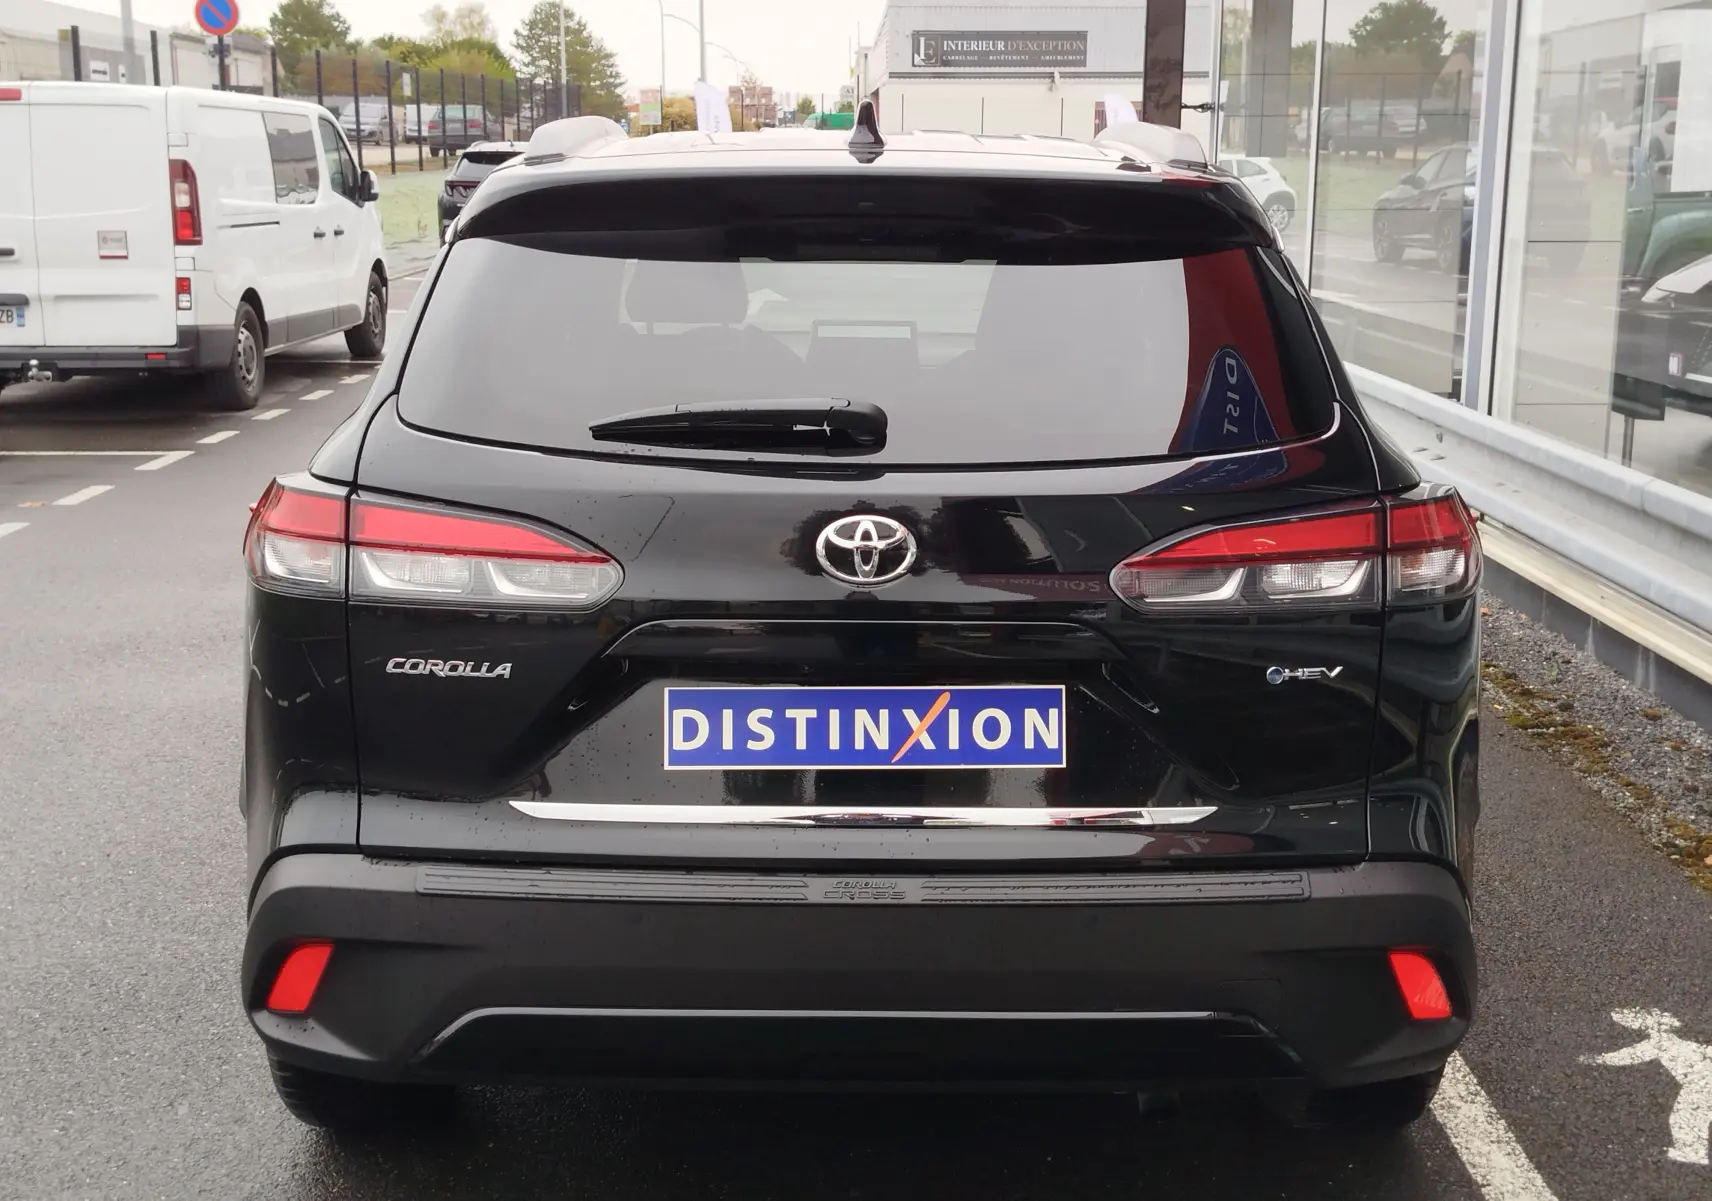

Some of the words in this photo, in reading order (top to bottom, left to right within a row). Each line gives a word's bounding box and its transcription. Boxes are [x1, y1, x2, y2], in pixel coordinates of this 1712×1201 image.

[943, 40, 1005, 51] INTERIEUR
[1007, 39, 1085, 51] D'EXCEPTION
[385, 657, 513, 679] COROLLA
[1283, 665, 1344, 681] HEV
[671, 697, 1060, 757] DISTINXION
[832, 879, 898, 890] COROLLA
[823, 889, 907, 901] CROSS
